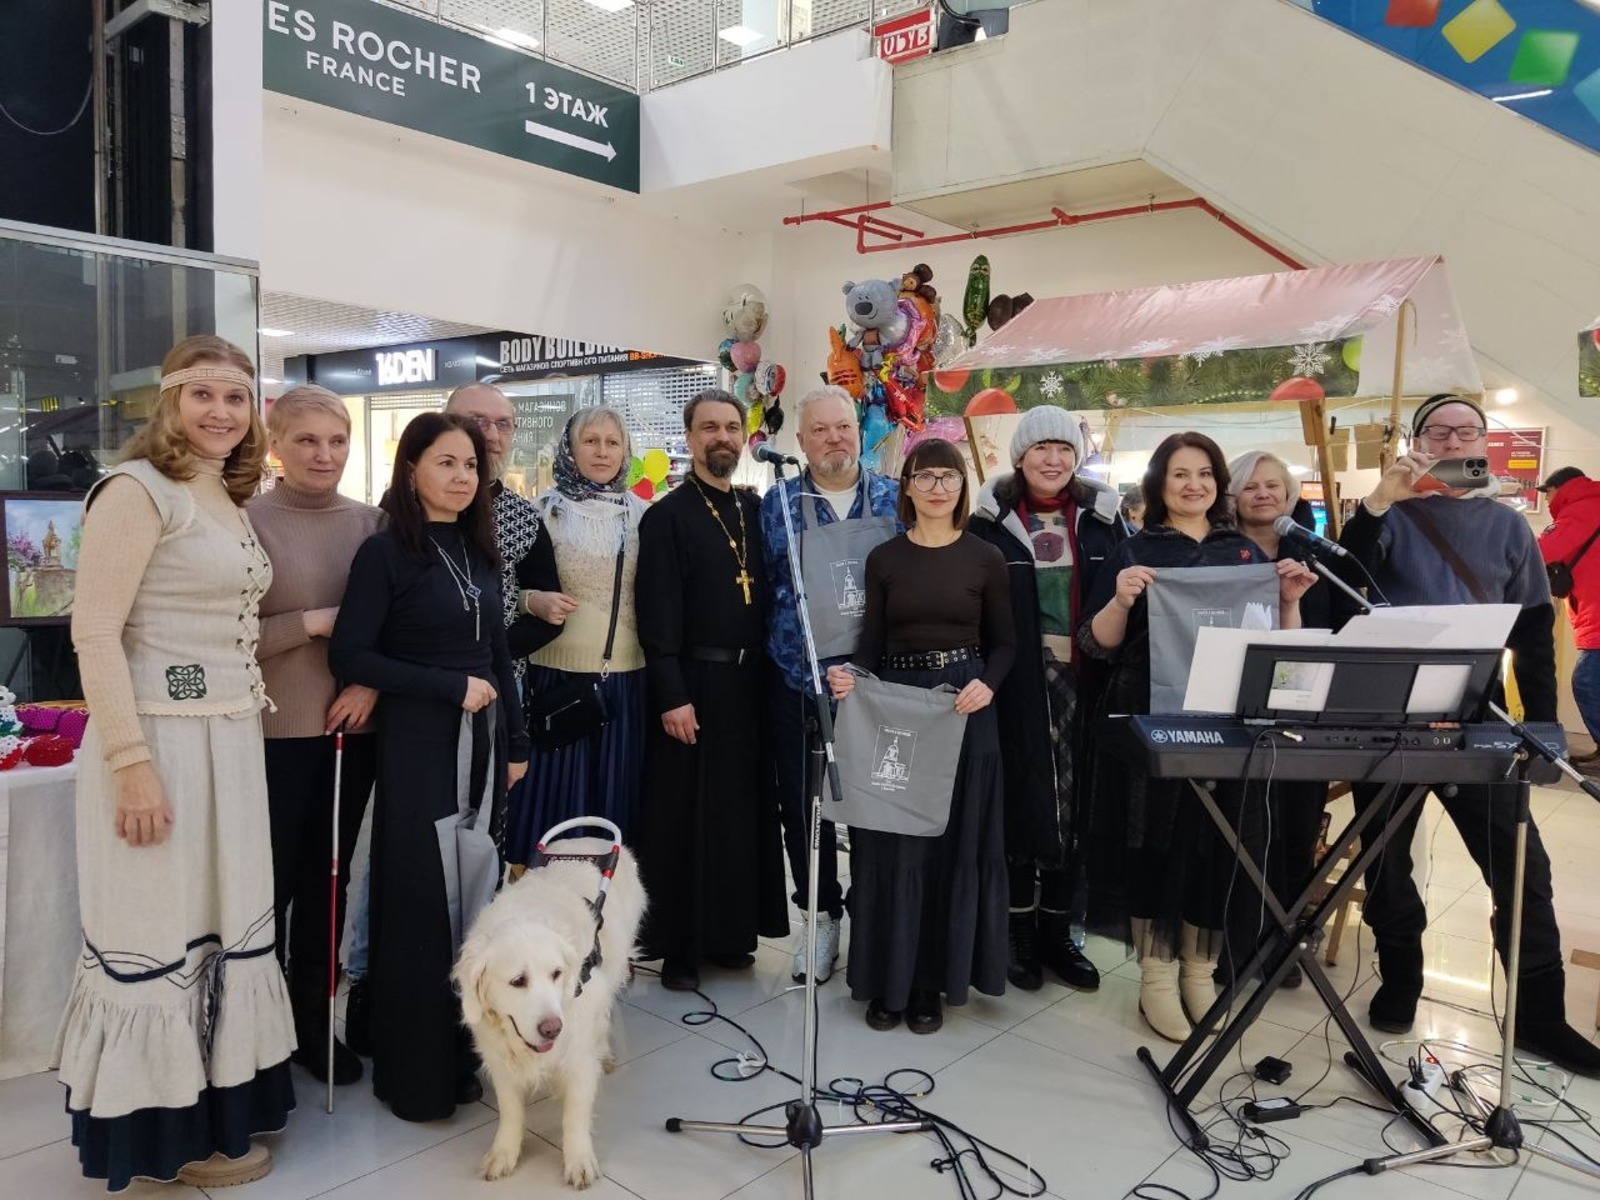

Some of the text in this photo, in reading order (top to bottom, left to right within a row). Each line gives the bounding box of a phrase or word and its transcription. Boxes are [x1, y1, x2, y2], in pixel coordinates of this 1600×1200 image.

[332, 21, 482, 94] ROCHER
[306, 51, 406, 97] FRANCE
[525, 82, 609, 129] 1 ЭТАЖ
[499, 337, 543, 365] BODY
[499, 365, 515, 373] СЕТЬ
[515, 362, 550, 372] МАГАЗИНОВ
[598, 353, 628, 364] ПИТАНИЯ
[518, 400, 567, 413] МАГАЗИНОВ
[1167, 730, 1224, 744] YAMAHA
